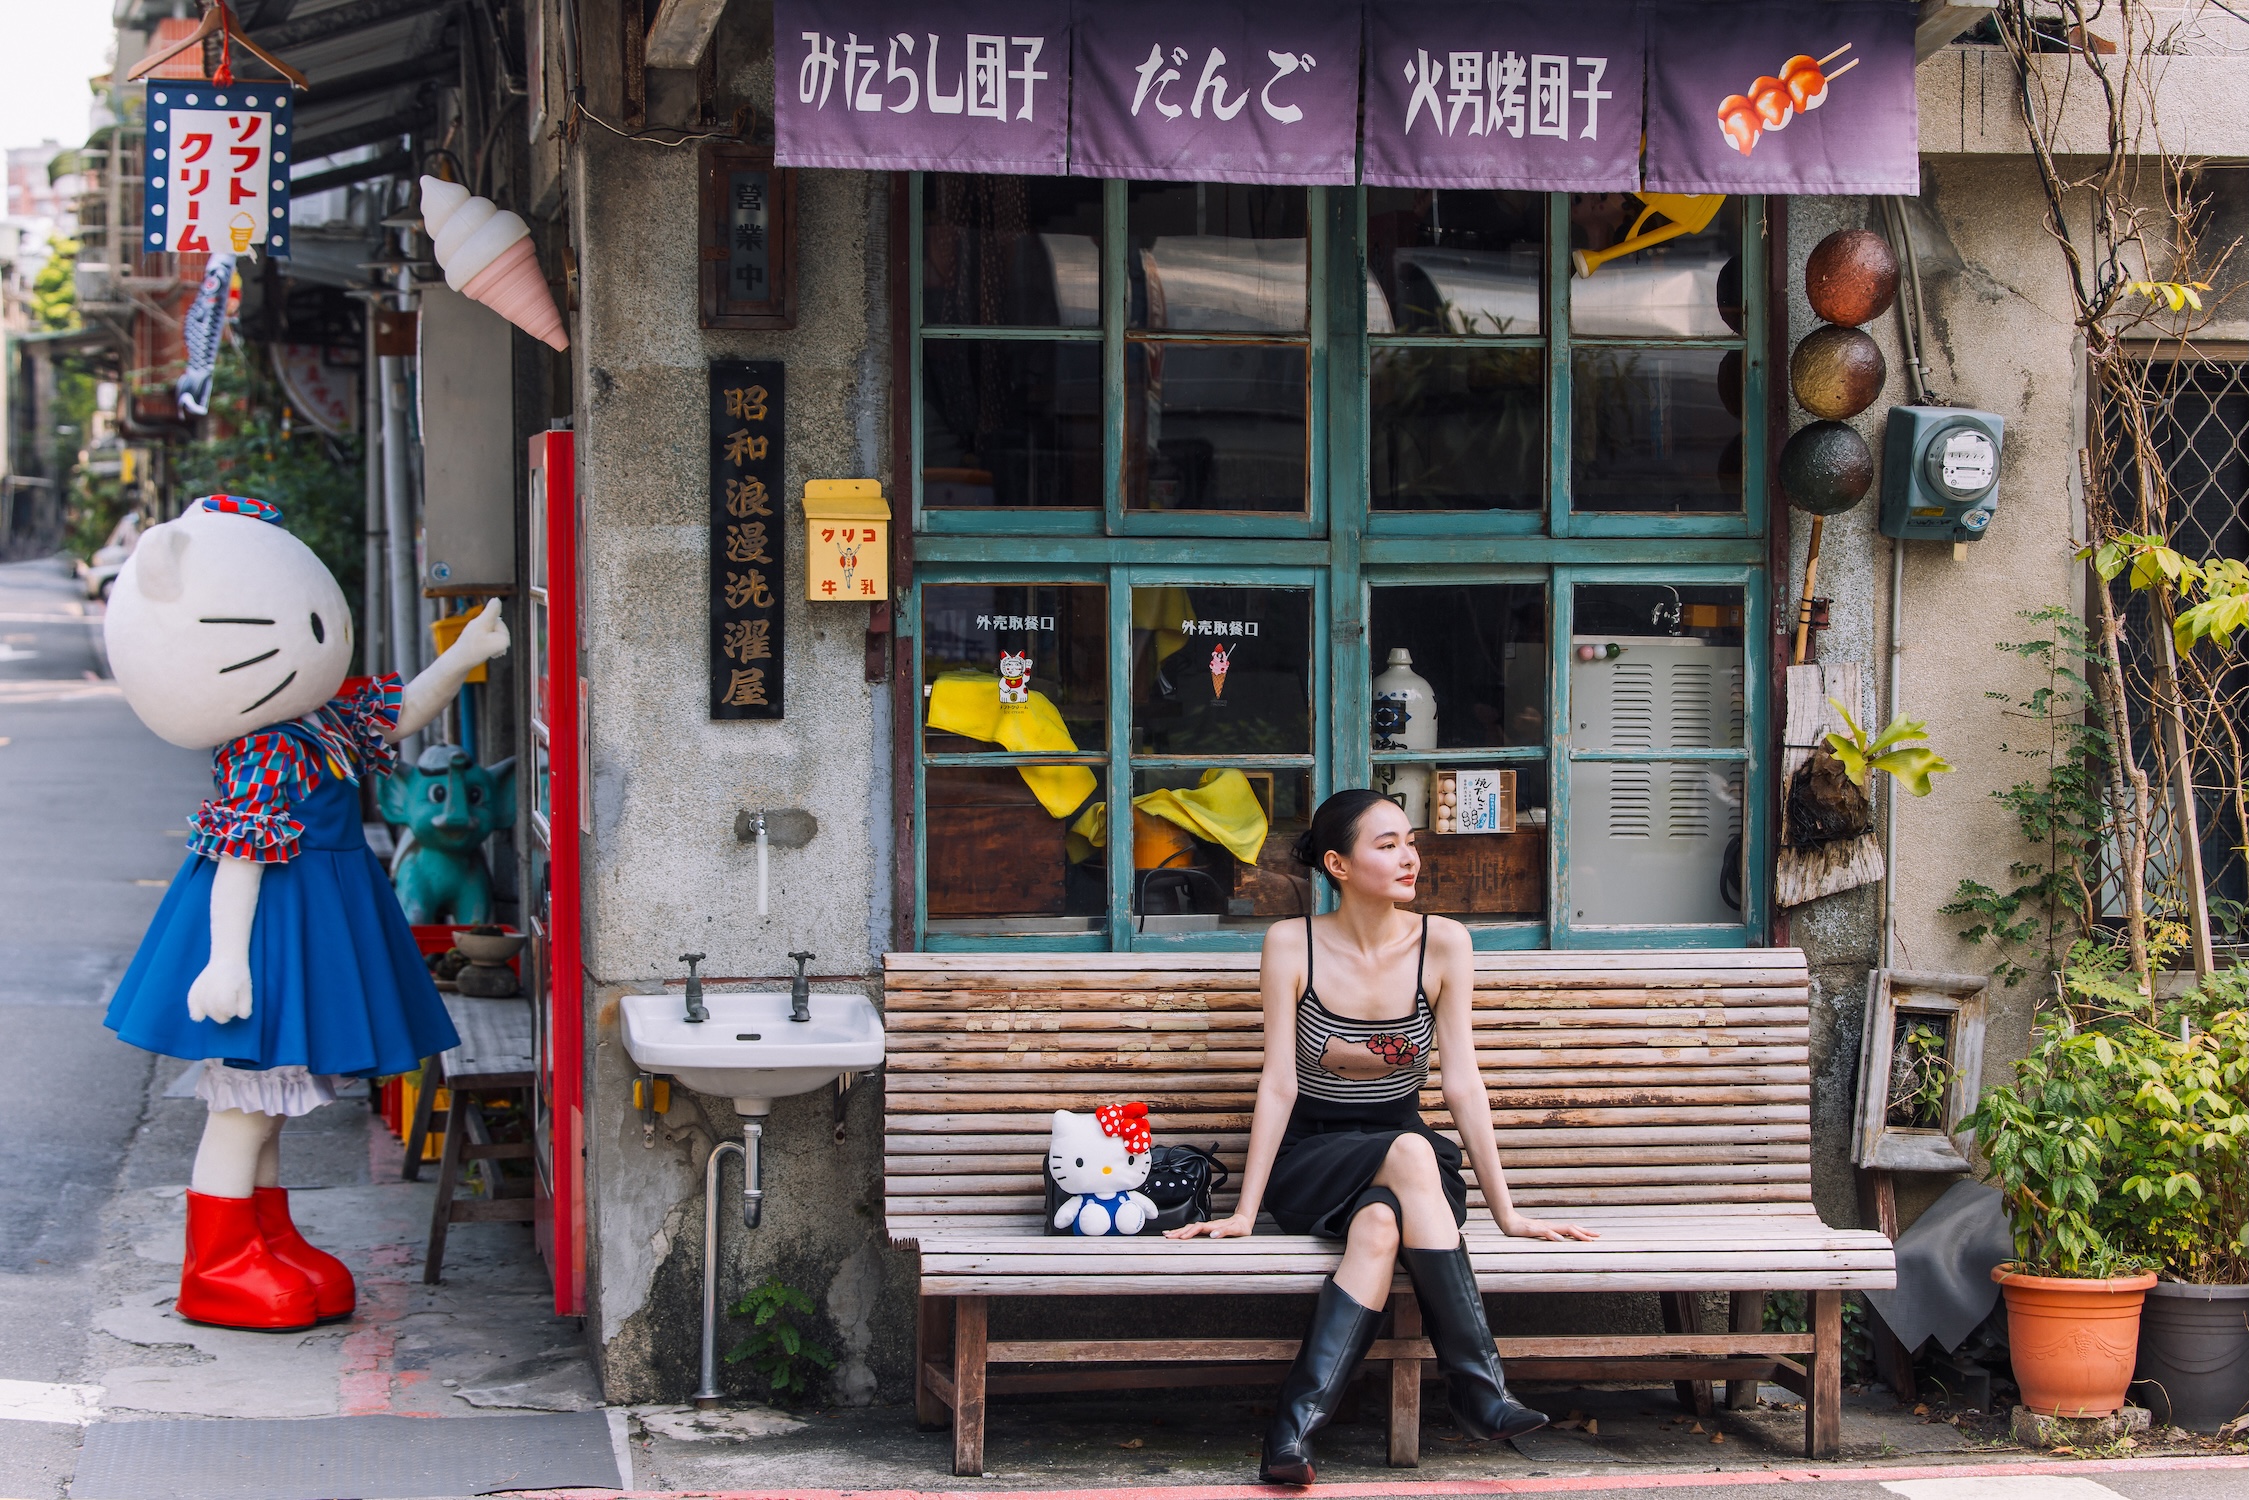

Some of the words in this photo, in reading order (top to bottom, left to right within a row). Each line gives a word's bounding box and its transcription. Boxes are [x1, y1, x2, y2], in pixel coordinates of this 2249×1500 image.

[800, 32, 1048, 123] みたらし団子
[1131, 43, 1317, 125] だんご
[177, 133, 213, 252] クリーム
[229, 116, 262, 205] ソフト
[721, 384, 775, 707] 昭和浪漫洗濯屋
[821, 579, 876, 595] 牛乳
